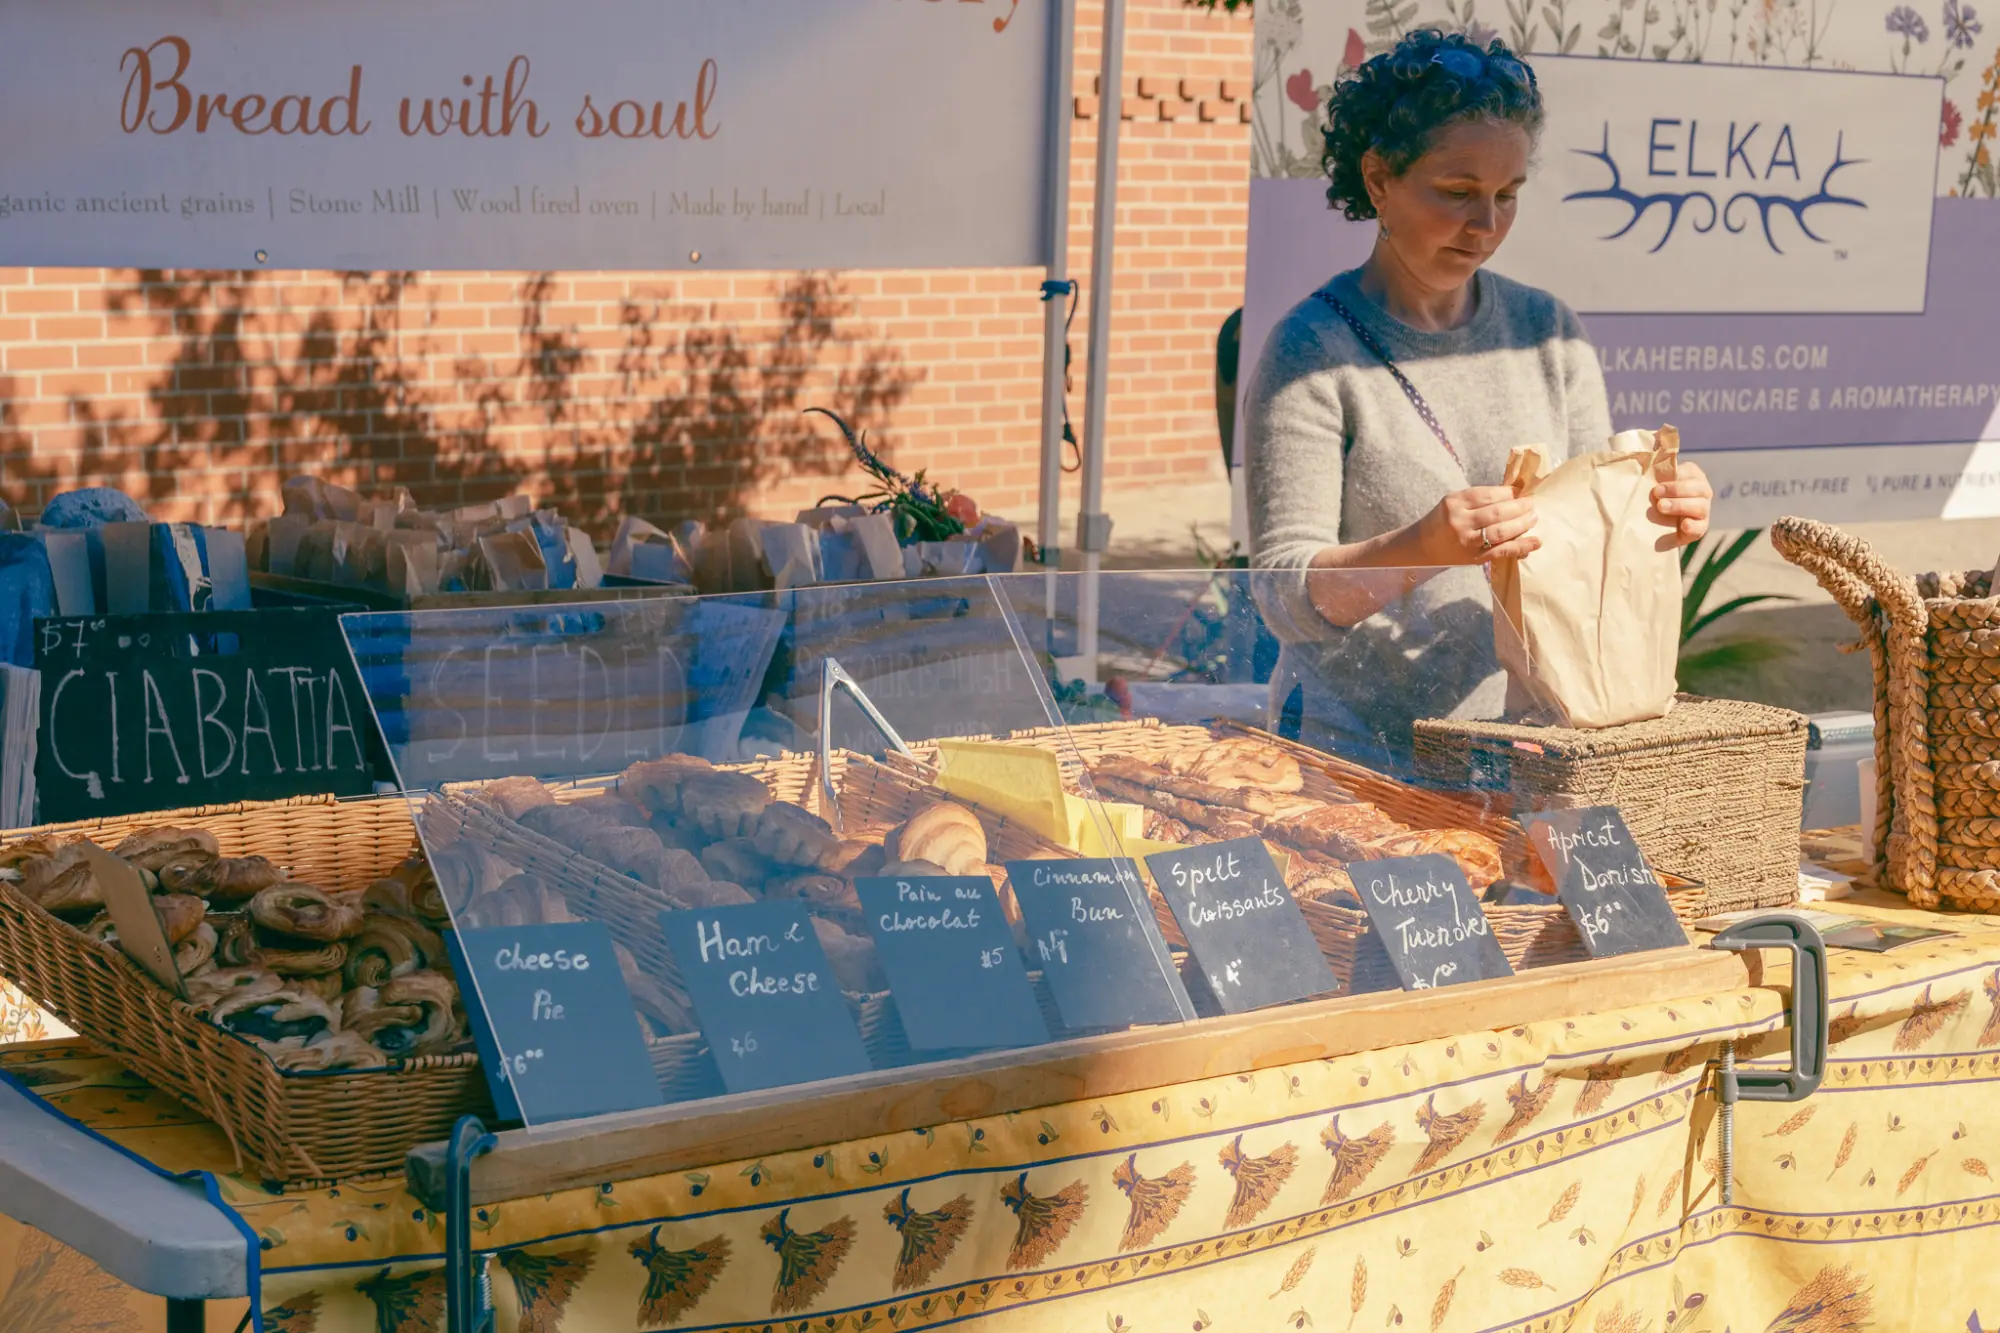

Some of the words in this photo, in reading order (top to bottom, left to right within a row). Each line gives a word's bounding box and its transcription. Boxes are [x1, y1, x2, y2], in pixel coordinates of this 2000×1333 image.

[119, 36, 371, 136] Bread
[399, 55, 550, 138] with
[575, 58, 720, 140] soul
[1648, 118, 1801, 181] ELKA
[0, 190, 66, 219] ganic
[76, 189, 170, 214] ancient
[180, 191, 256, 220] grains
[288, 187, 363, 215] Stone
[372, 184, 422, 214] Mill
[452, 185, 522, 214] Wood
[531, 185, 582, 214] fired
[589, 198, 640, 215] oven
[669, 187, 726, 216] Made
[732, 187, 755, 221] by
[762, 187, 809, 216] hand
[835, 188, 886, 216] Local
[1601, 344, 1829, 372] LKAHERBALS.COM
[1613, 388, 1671, 416] ANIC
[1680, 387, 1799, 414] SKINCARE
[1808, 386, 1822, 411] &
[1739, 477, 1850, 498] CRUELTY-FREE
[1882, 475, 1920, 493] PURE
[861, 650, 1014, 699] OURDOUGH
[428, 643, 688, 765] SEEDED
[51, 666, 366, 798] CIABATTA
[1548, 816, 1621, 864] Apricot
[896, 881, 942, 903] Pain
[954, 887, 982, 900] au
[1034, 866, 1138, 887] Cinnamon
[1171, 852, 1241, 898] Spelt
[1573, 852, 1657, 892] Danish
[1071, 897, 1124, 923] Bun
[1188, 879, 1285, 928] Croissants
[1371, 873, 1461, 927] Cherry
[696, 920, 780, 963] Ham
[729, 967, 822, 997] Cheese
[532, 989, 566, 1021] Pie
